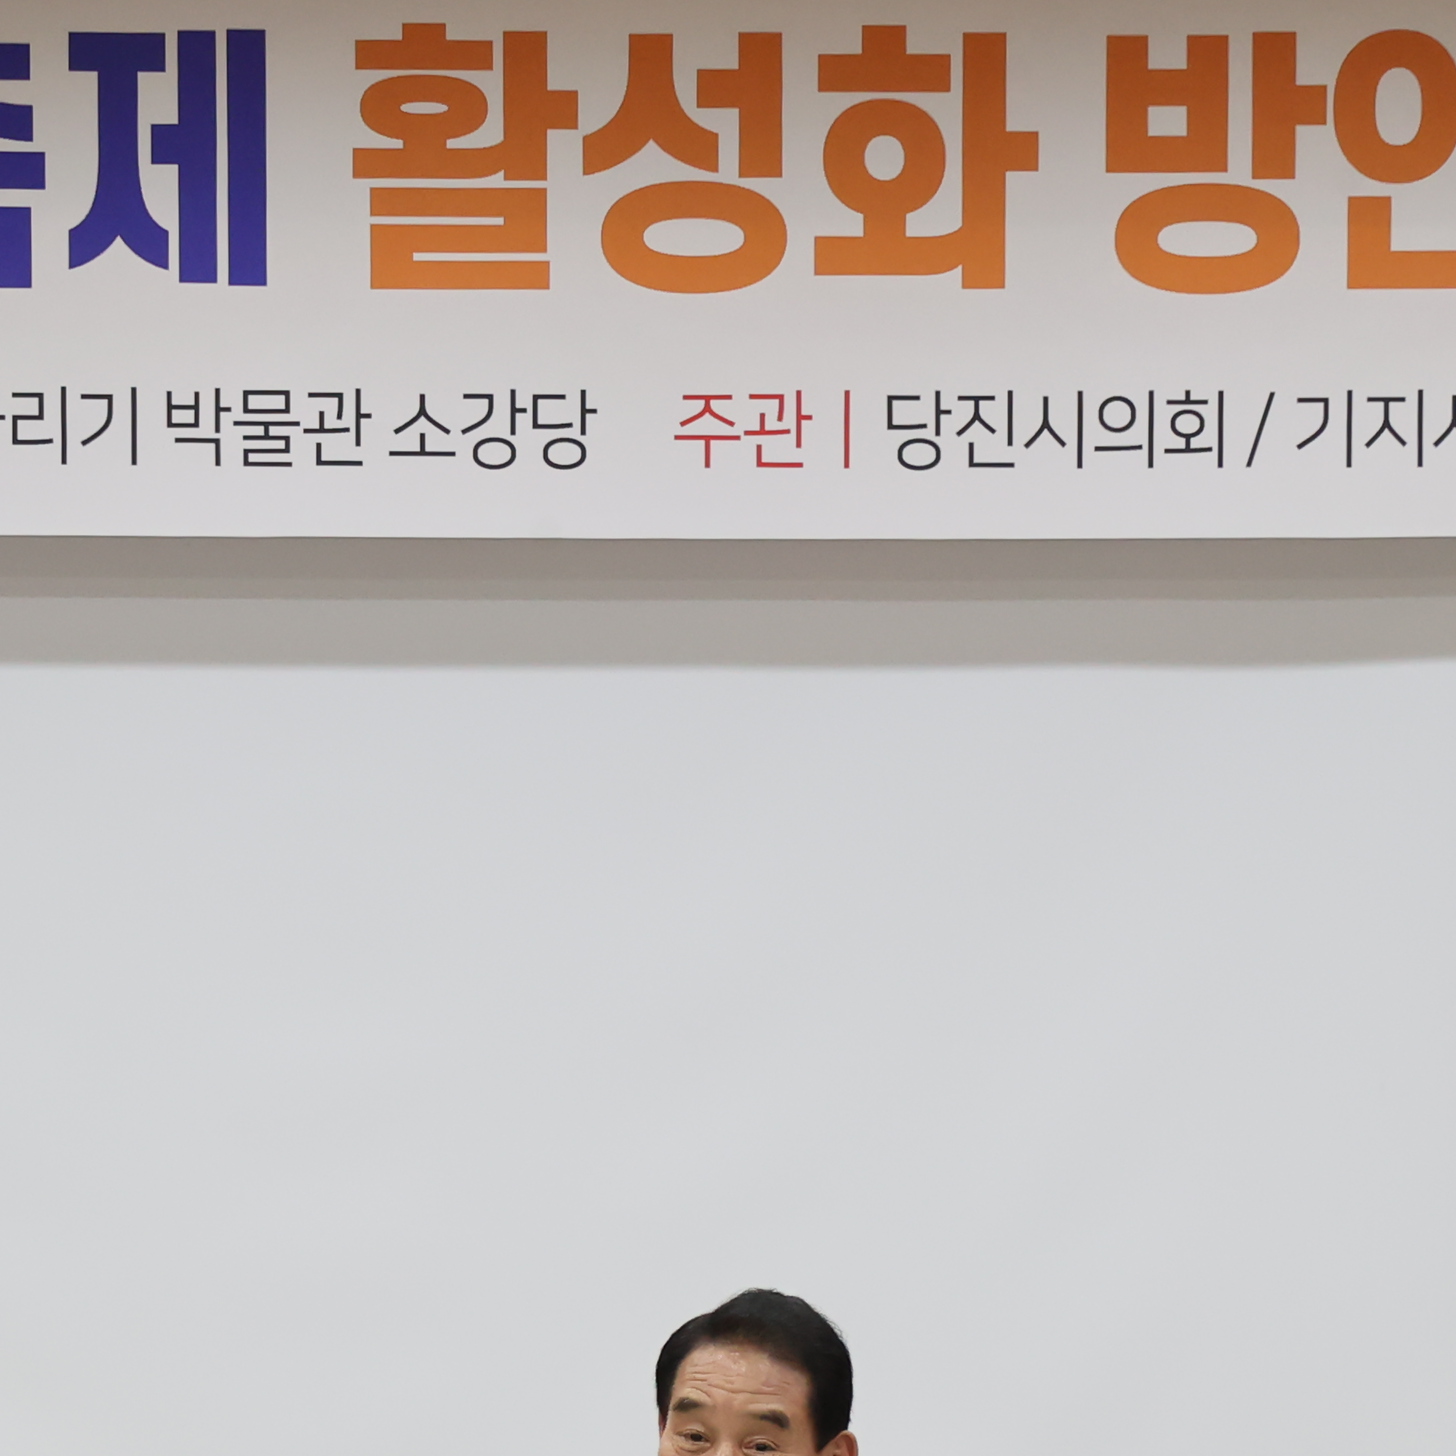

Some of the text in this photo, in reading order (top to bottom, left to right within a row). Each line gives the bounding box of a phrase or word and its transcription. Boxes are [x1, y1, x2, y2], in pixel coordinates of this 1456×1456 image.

[353, 23, 1039, 294] 활성화
[167, 388, 372, 467] 박물관
[389, 389, 597, 469] 소강당
[675, 391, 812, 467] 주관
[887, 390, 1223, 470] 당진시의회
